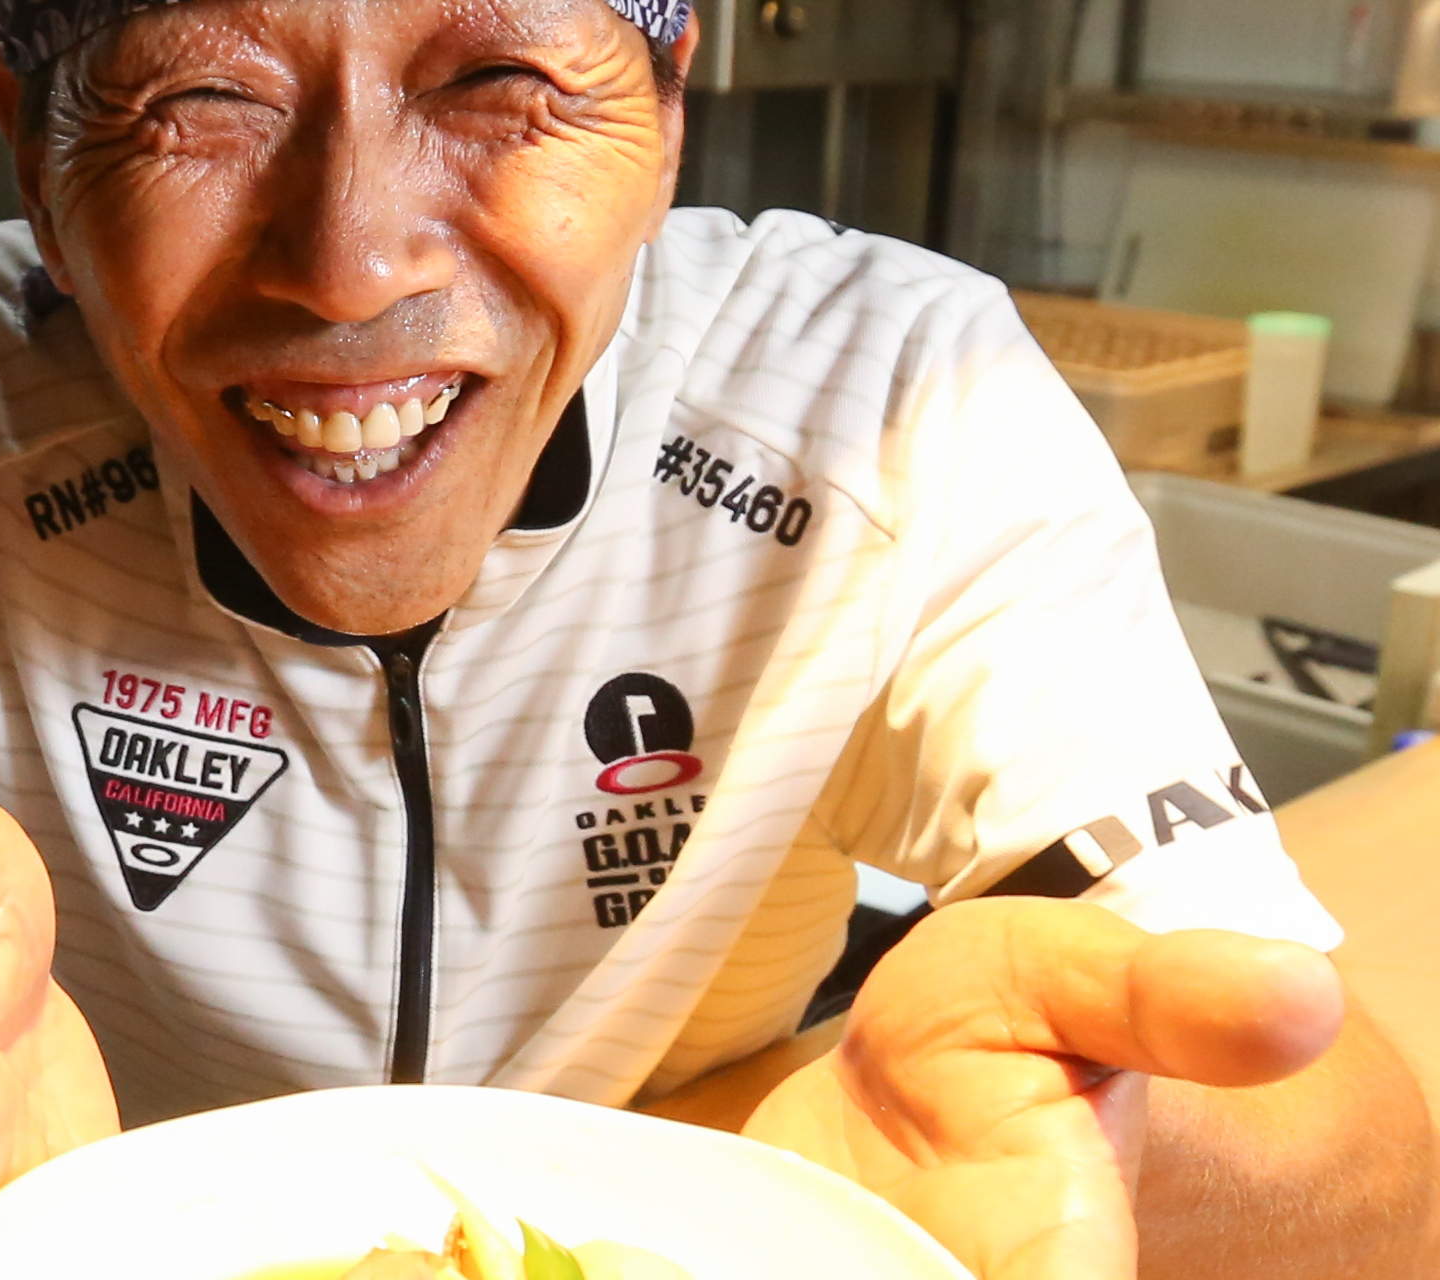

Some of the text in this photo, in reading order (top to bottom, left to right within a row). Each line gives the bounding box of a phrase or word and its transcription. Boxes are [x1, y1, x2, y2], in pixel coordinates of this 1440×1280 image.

[653, 435, 812, 546] #35460
[102, 669, 273, 739] 1975 MFG
[99, 726, 251, 793] OAKLEY
[105, 779, 226, 822] CALIFORNIA
[576, 795, 706, 829] OAKLE
